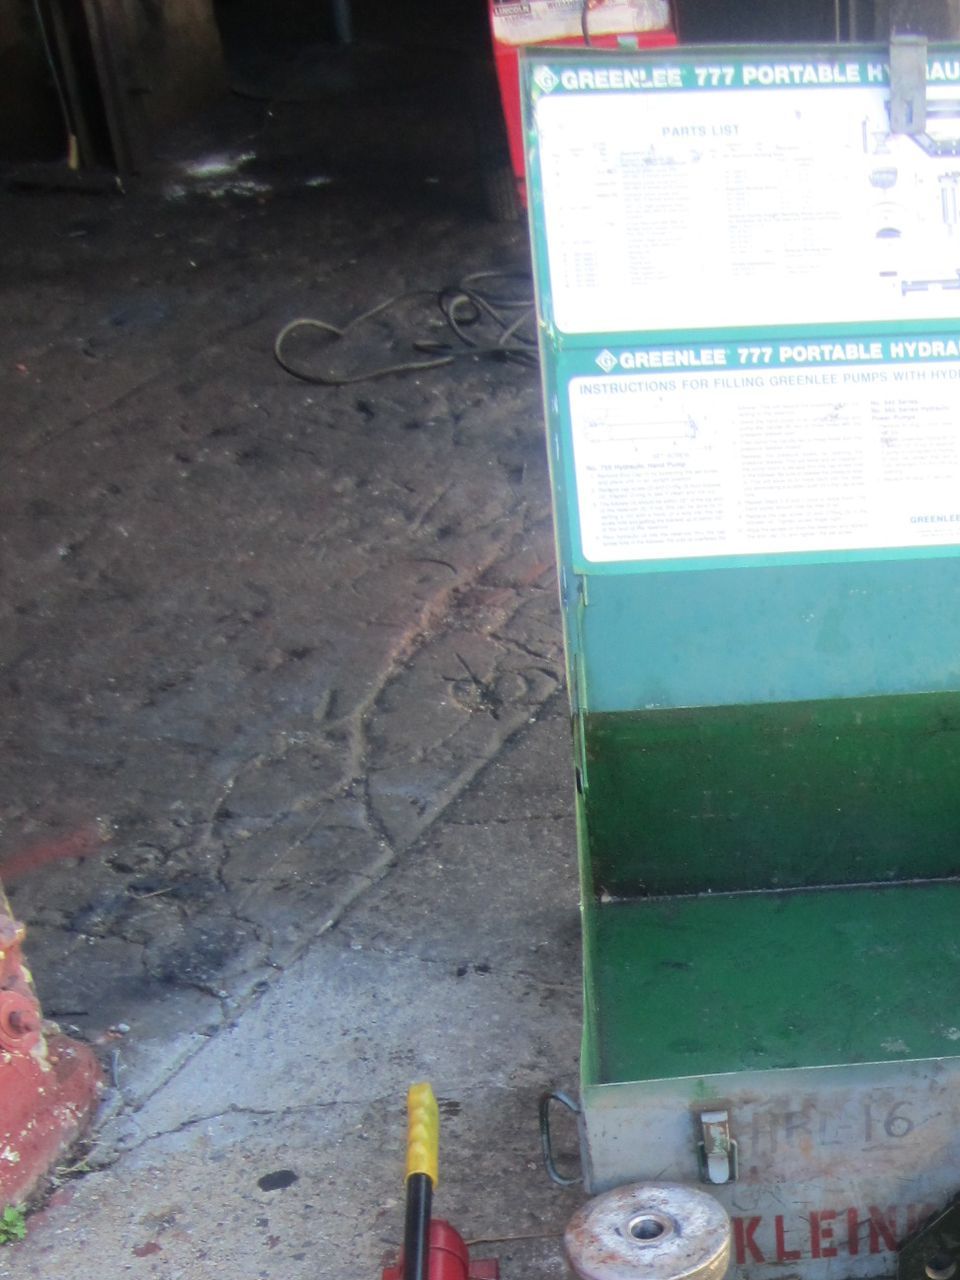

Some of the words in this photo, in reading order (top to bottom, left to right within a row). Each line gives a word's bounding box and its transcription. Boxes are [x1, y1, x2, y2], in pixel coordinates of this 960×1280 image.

[495, 5, 530, 16] LINCOLN
[561, 68, 683, 90] GREENLEE
[695, 66, 735, 86] 777
[743, 64, 860, 85] PORTABLE
[662, 125, 706, 137] PARTS
[711, 124, 739, 137] LIST
[619, 349, 727, 369] GREENLEE
[737, 346, 774, 365] 777
[779, 342, 884, 363] PORTABLE
[579, 378, 677, 396] INSTRUCTIONS
[681, 378, 709, 391] FOR
[713, 376, 764, 389] FILLING
[768, 374, 838, 387] GREENLEE
[843, 371, 888, 385] PUMPS
[893, 369, 926, 381] WITH
[910, 514, 960, 524] GREENLEE
